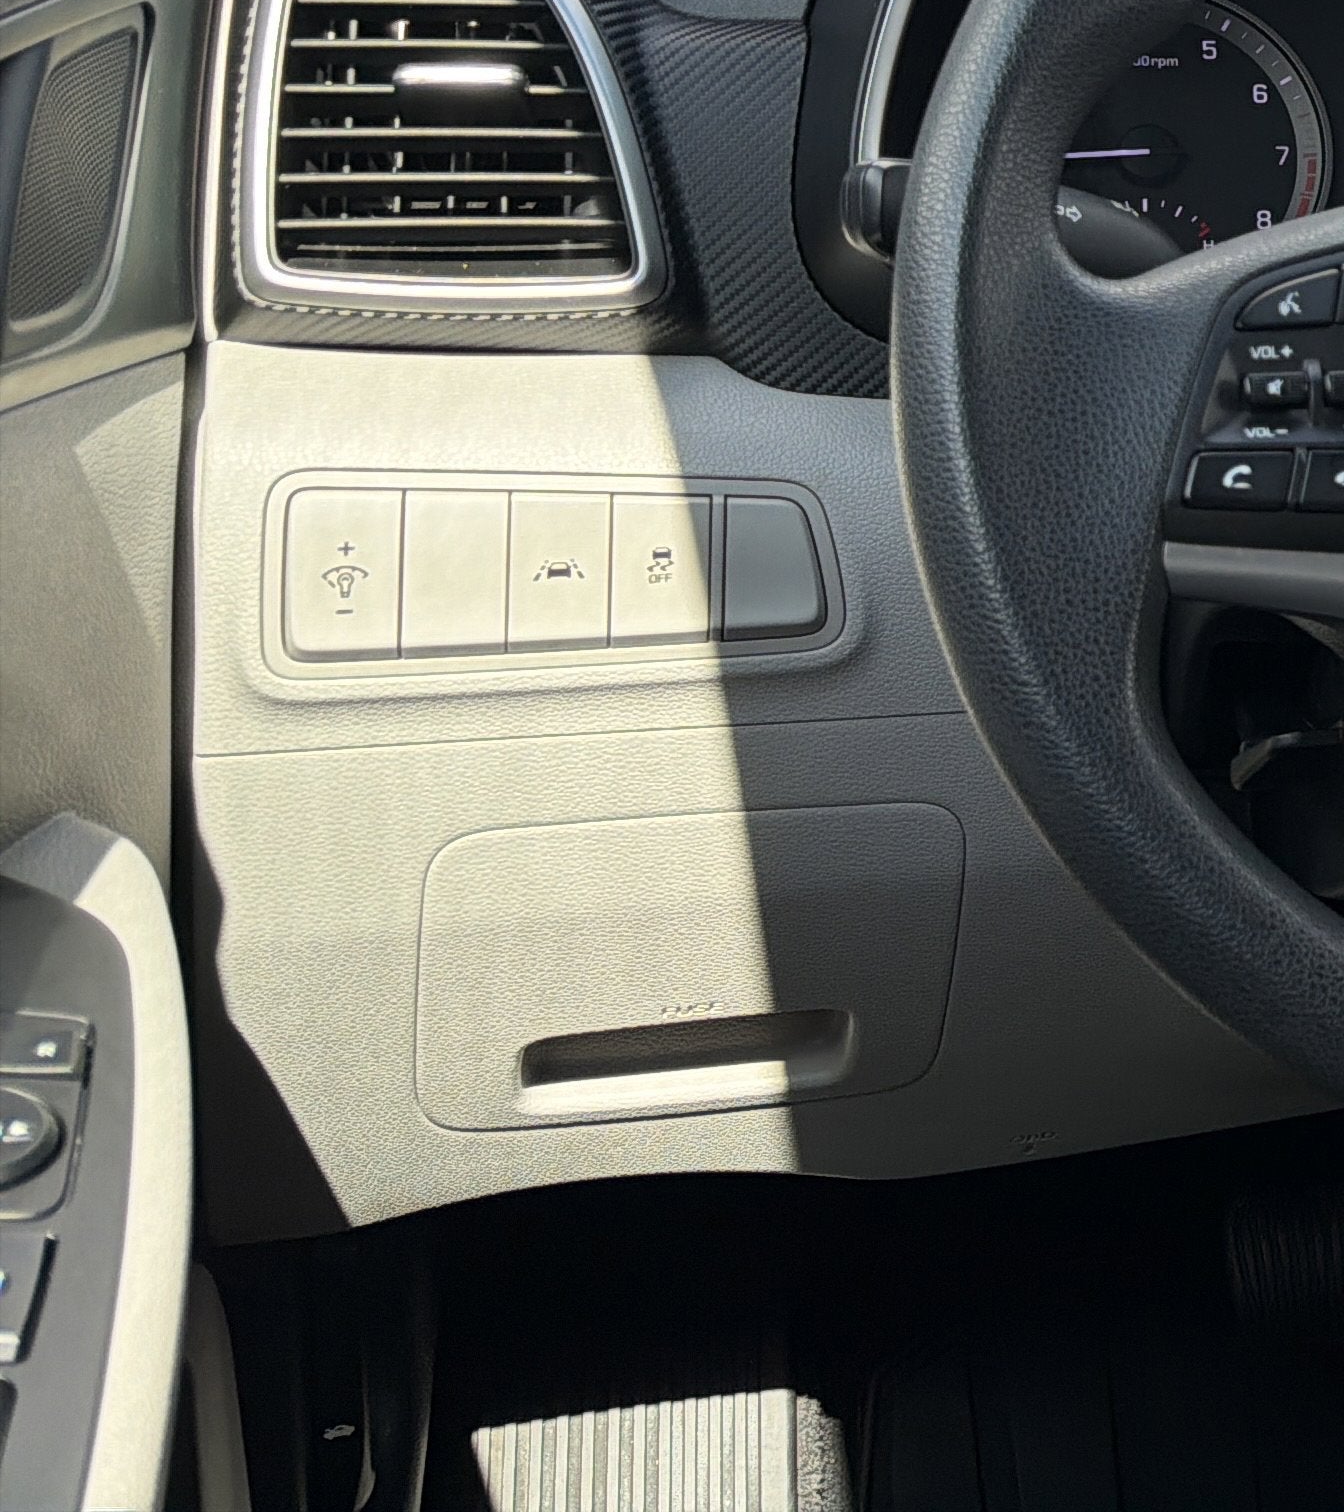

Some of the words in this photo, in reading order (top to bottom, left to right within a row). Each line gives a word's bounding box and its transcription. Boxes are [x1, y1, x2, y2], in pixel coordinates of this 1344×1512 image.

[1201, 41, 1217, 60] 5
[1252, 83, 1268, 104] 6
[1275, 145, 1289, 166] 7
[1256, 209, 1272, 230] 8
[648, 572, 673, 584] OFF
